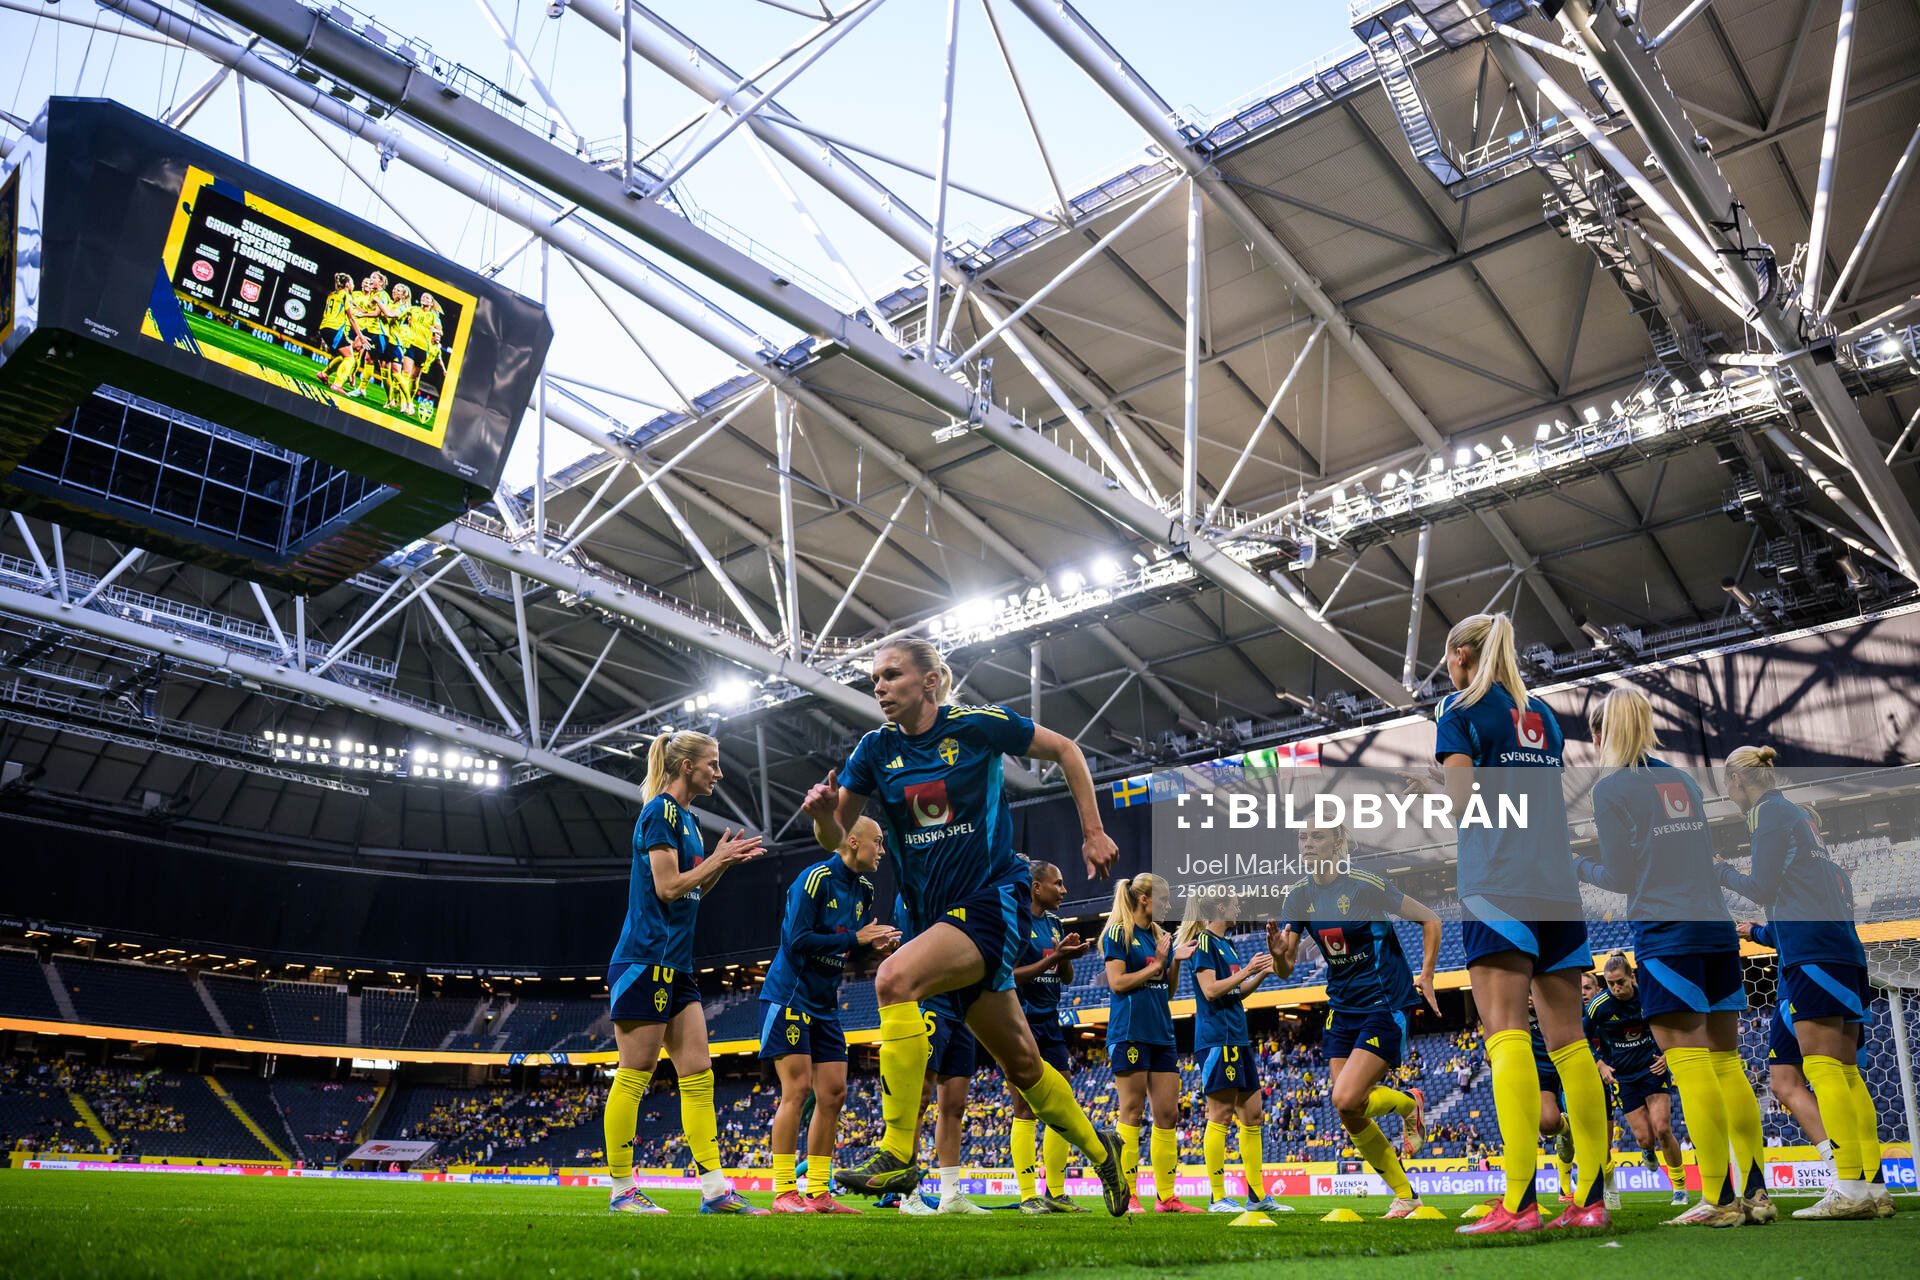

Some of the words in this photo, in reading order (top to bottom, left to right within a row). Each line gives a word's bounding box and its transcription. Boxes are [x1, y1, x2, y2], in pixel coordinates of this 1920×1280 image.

[241, 218, 291, 250] SVERIGES
[205, 215, 319, 275] GRUPPSPELSMATCHER
[233, 240, 240, 252] I
[239, 243, 287, 273] SOMMAR
[84, 318, 119, 336] Strawberry
[91, 327, 110, 338] Arena
[1500, 752, 1544, 764] SVENSKA
[1546, 755, 1561, 767] SPE
[1215, 765, 1241, 777] UEFA
[1153, 779, 1179, 793] FIFA
[947, 823, 975, 836] SPEL
[1653, 822, 1692, 838] SVENSKA
[1692, 821, 1704, 831] SP
[1223, 1046, 1240, 1062] 13
[1797, 1168, 1831, 1177] SVENS
[1074, 1182, 1104, 1196] väge
[1432, 1175, 1484, 1194] vägen
[1487, 1174, 1507, 1193] frå
[1629, 1169, 1660, 1189] elit
[1799, 1178, 1824, 1187] SPEL
